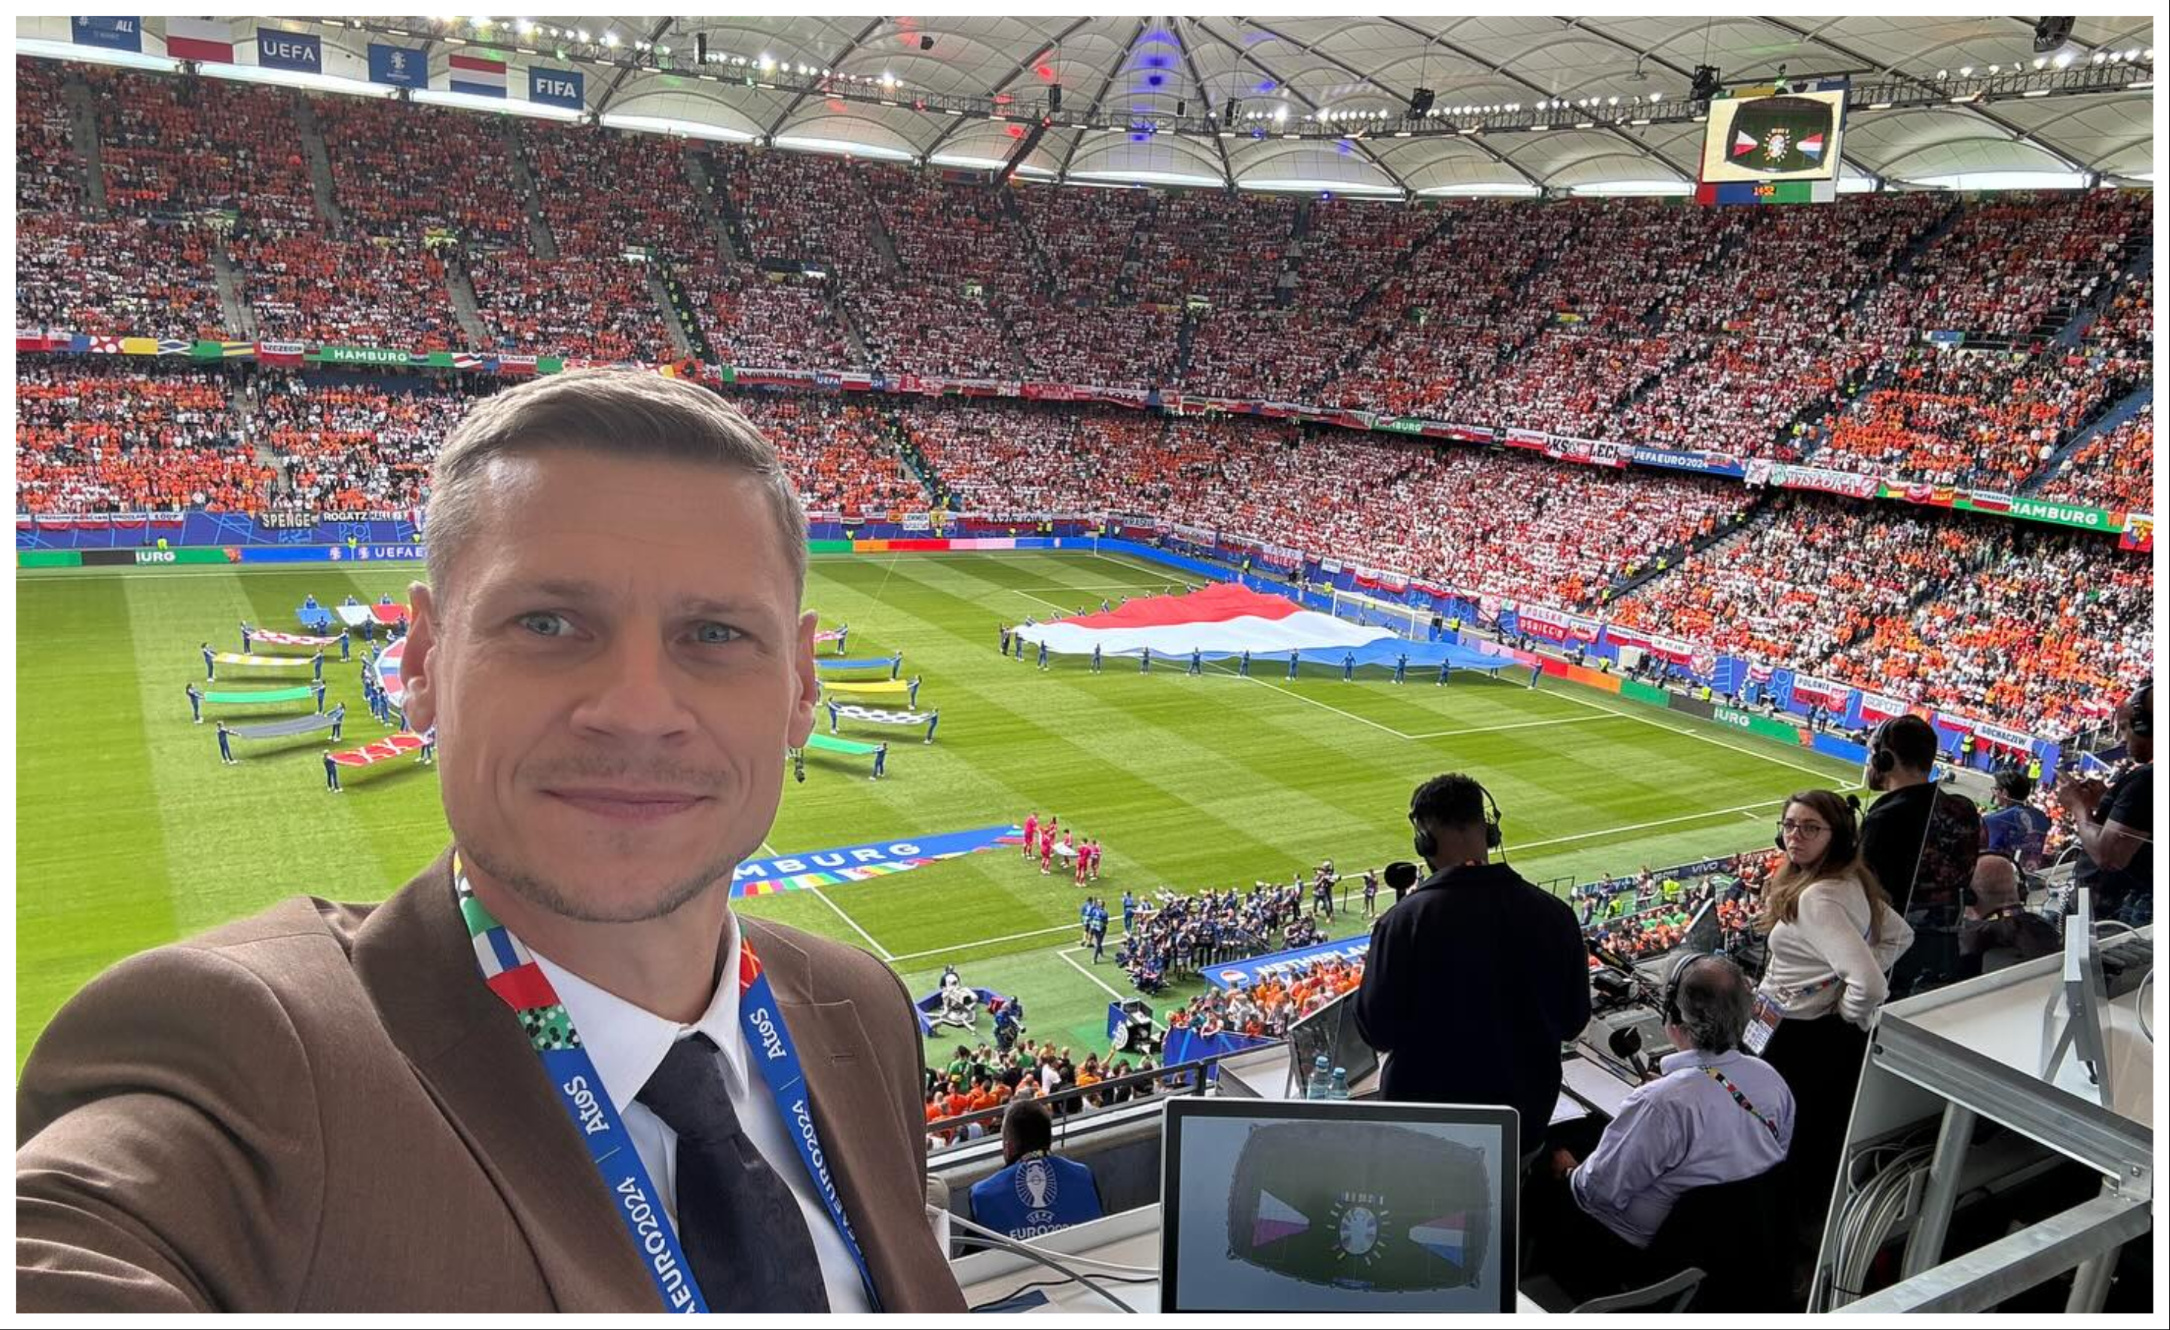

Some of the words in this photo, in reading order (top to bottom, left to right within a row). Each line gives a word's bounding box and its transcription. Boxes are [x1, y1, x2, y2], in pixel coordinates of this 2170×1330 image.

[263, 40, 316, 62] UEFA
[536, 78, 577, 98] FIFA
[334, 349, 408, 363] HAMBURG
[262, 511, 311, 528] SPENGE
[2010, 501, 2099, 525] HAMBURG
[1980, 725, 2028, 747] SOCHACZEW
